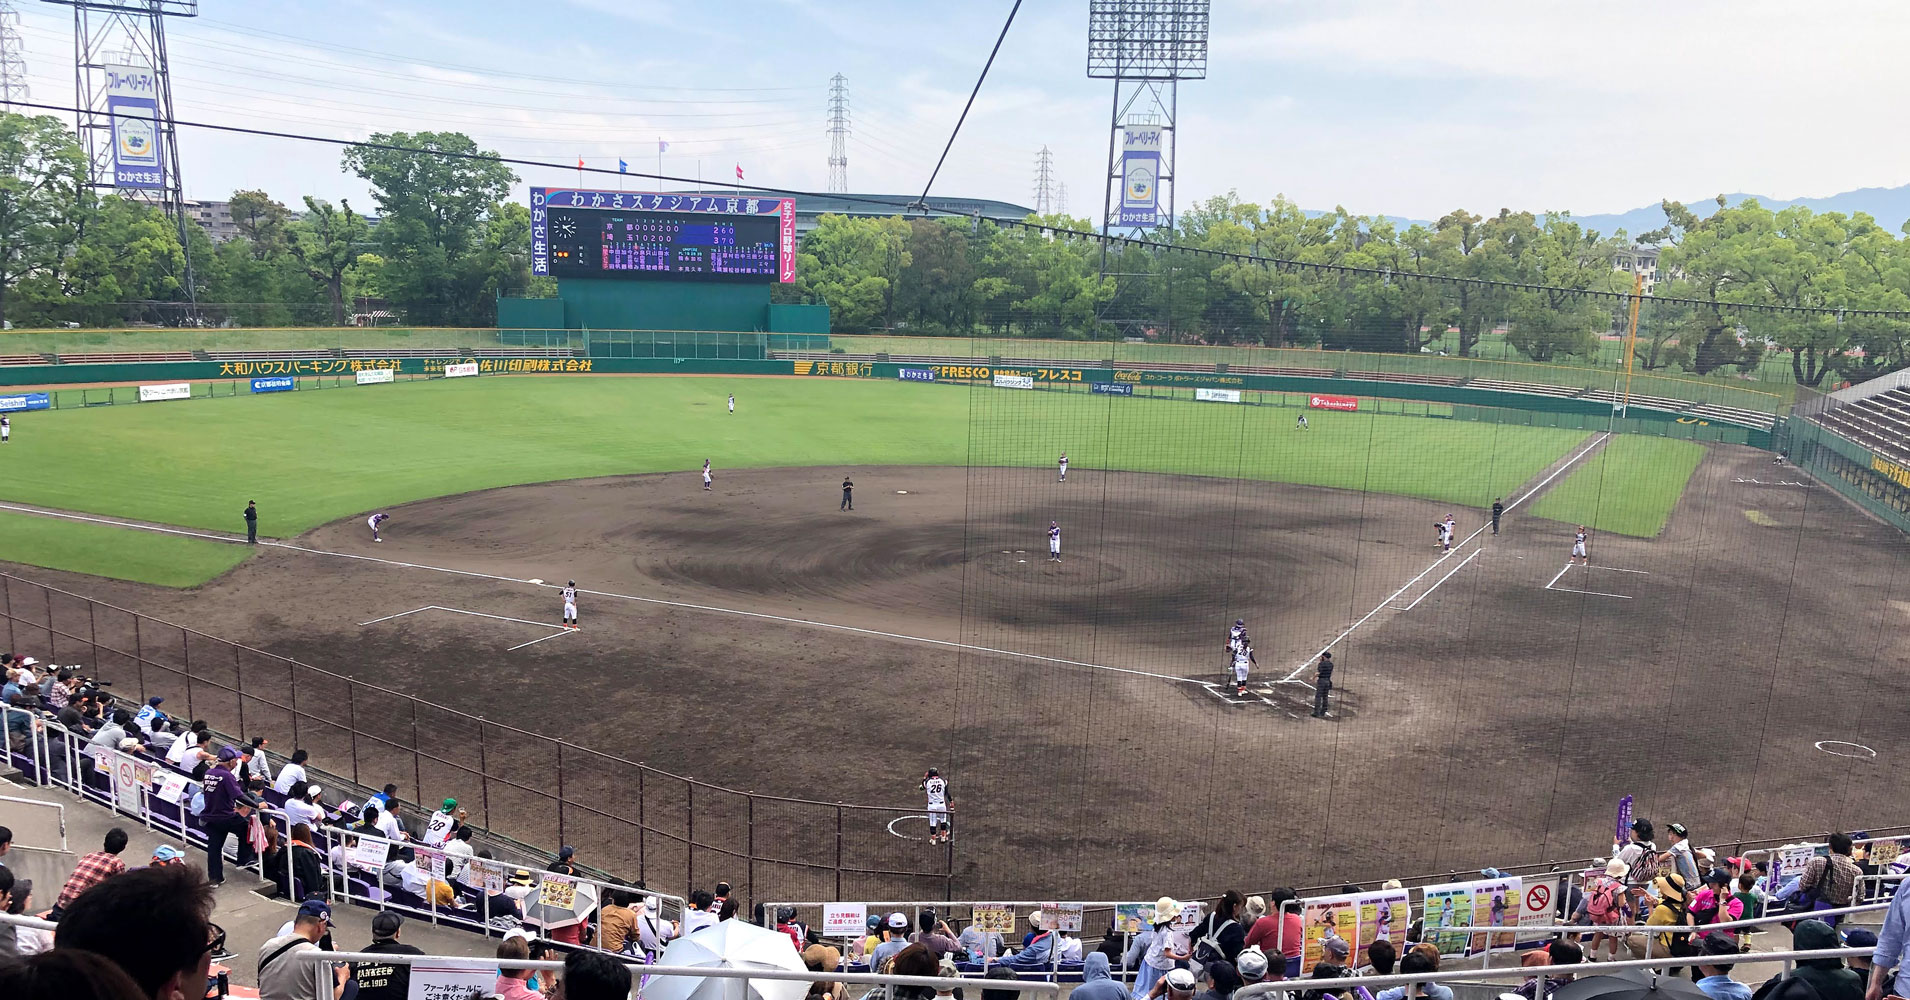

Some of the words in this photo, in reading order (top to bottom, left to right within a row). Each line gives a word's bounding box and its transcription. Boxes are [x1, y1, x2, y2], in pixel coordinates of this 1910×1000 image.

[108, 72, 153, 92] ブルーベリーアイ
[1125, 131, 1160, 145] ブルーベリーアイ
[118, 171, 160, 184] わかさ生活
[571, 191, 759, 214] わかさスタジアム京都
[1122, 212, 1155, 223] わかさ生活
[533, 191, 547, 272] わかさ生活
[783, 200, 794, 280] 女子プロ野球リーグ
[480, 359, 592, 372] 佐川印刷株式会社
[816, 361, 873, 376] 京都銀行
[906, 370, 934, 380] わかさ生活
[941, 366, 989, 378] FRESCO
[1038, 369, 1082, 380] フレスコ
[930, 784, 941, 793] 26
[428, 819, 445, 831] 28
[371, 979, 388, 988] 1903
[423, 983, 482, 992] ファールボールに
